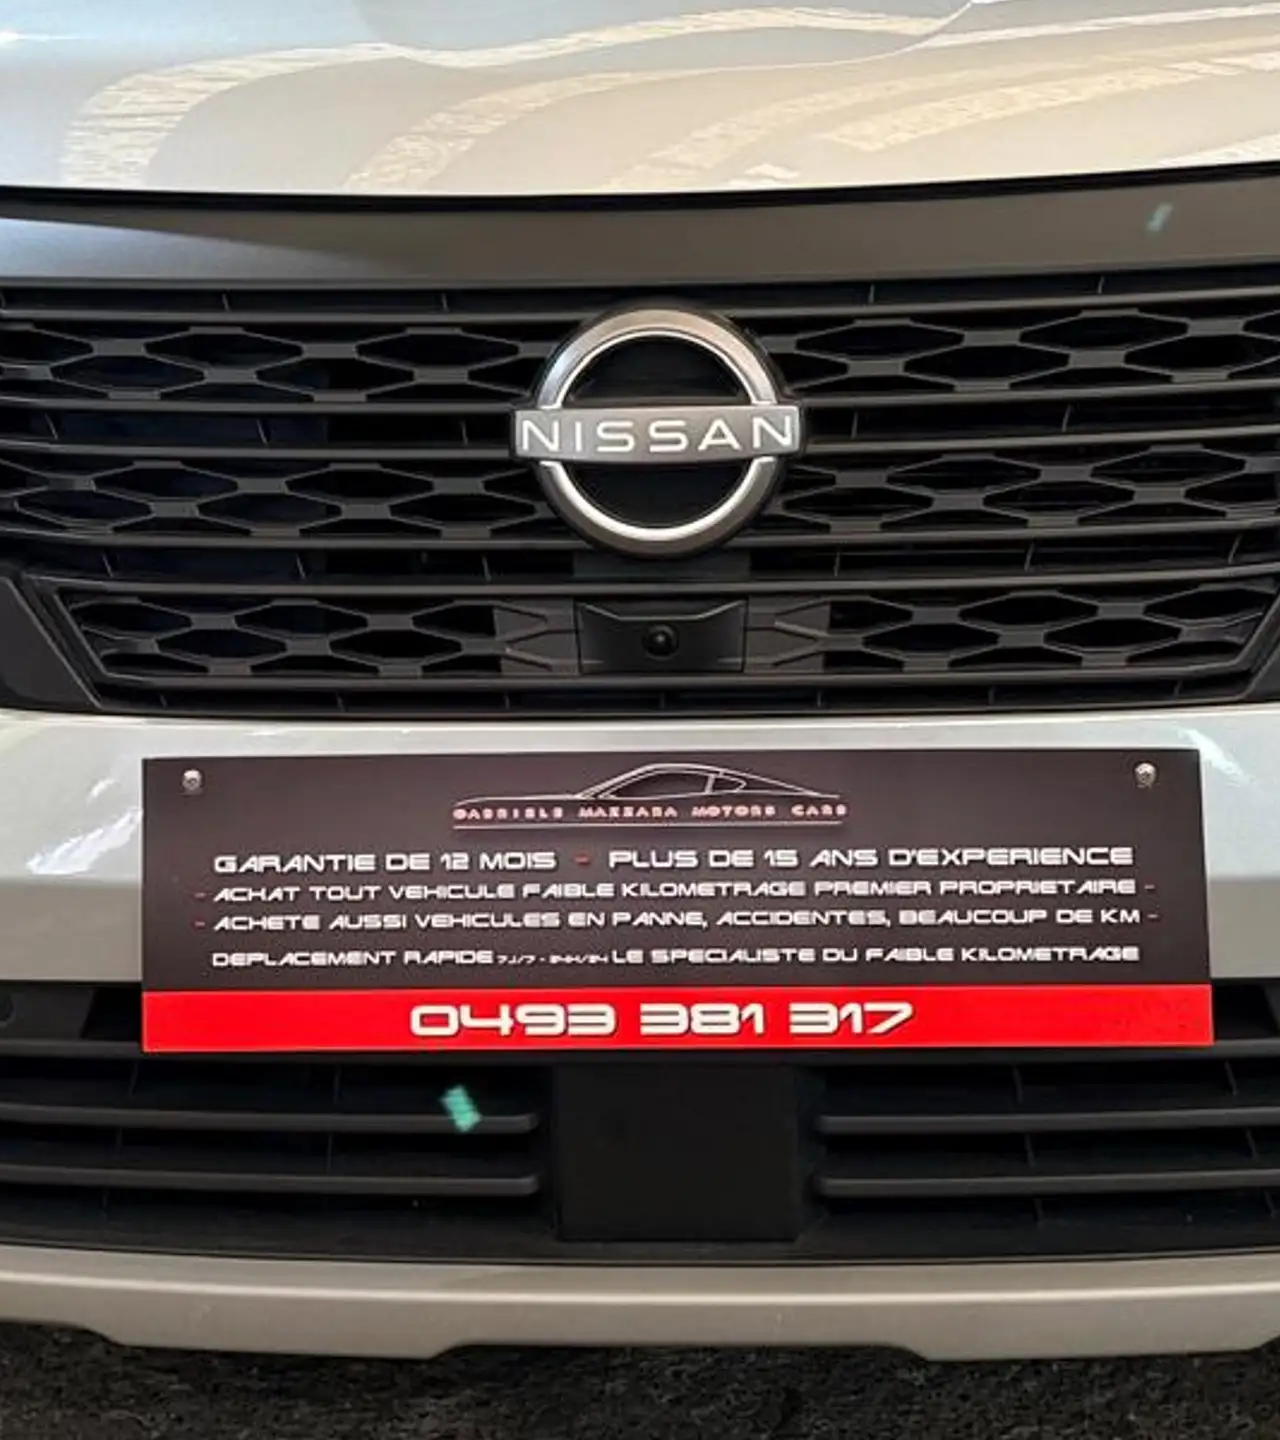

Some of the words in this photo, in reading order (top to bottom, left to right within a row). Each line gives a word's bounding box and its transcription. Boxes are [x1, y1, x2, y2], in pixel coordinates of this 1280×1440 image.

[521, 415, 793, 454] NISSAN
[691, 805, 776, 818] MOTORS
[790, 804, 847, 817] CARS
[213, 853, 377, 873] GARANTIE
[384, 852, 431, 872] DE
[439, 852, 470, 871] 12
[479, 851, 557, 870] MOIS
[608, 849, 699, 869] PLUS
[708, 849, 755, 868] DE
[762, 849, 799, 868] 15
[808, 848, 879, 868] ANS
[887, 846, 1134, 867] D'EXPERIENCE
[213, 885, 301, 902] ACHAT
[308, 885, 382, 901] TOUT
[388, 883, 516, 900] VEHICULE
[521, 882, 615, 899] FAIBLE
[620, 880, 806, 898] KILOMETRAGE
[813, 880, 932, 897] PREMIER
[938, 878, 1136, 895] PROPRIETAIRE
[213, 914, 321, 931] ACHETE
[328, 913, 407, 930] AUSSI
[414, 911, 561, 929] VEHICULES
[567, 911, 606, 927] EN
[611, 910, 708, 929] PANNE,
[715, 909, 892, 928] ACCIDENTES,
[898, 908, 1048, 926] BEAUCOUP
[1055, 908, 1094, 924] DE
[1100, 908, 1141, 924] KM
[212, 950, 397, 967] DEPLACEMENT
[403, 949, 494, 965] RAPIDE
[611, 948, 644, 964] LE
[650, 947, 816, 964] SPECIALISTE
[822, 947, 858, 962] DU
[865, 947, 954, 962] FAIBLE
[961, 946, 1140, 962] KILOMETRAGE
[410, 1003, 617, 1038] 0493
[639, 1003, 766, 1037] 381
[789, 1001, 914, 1036] 317
